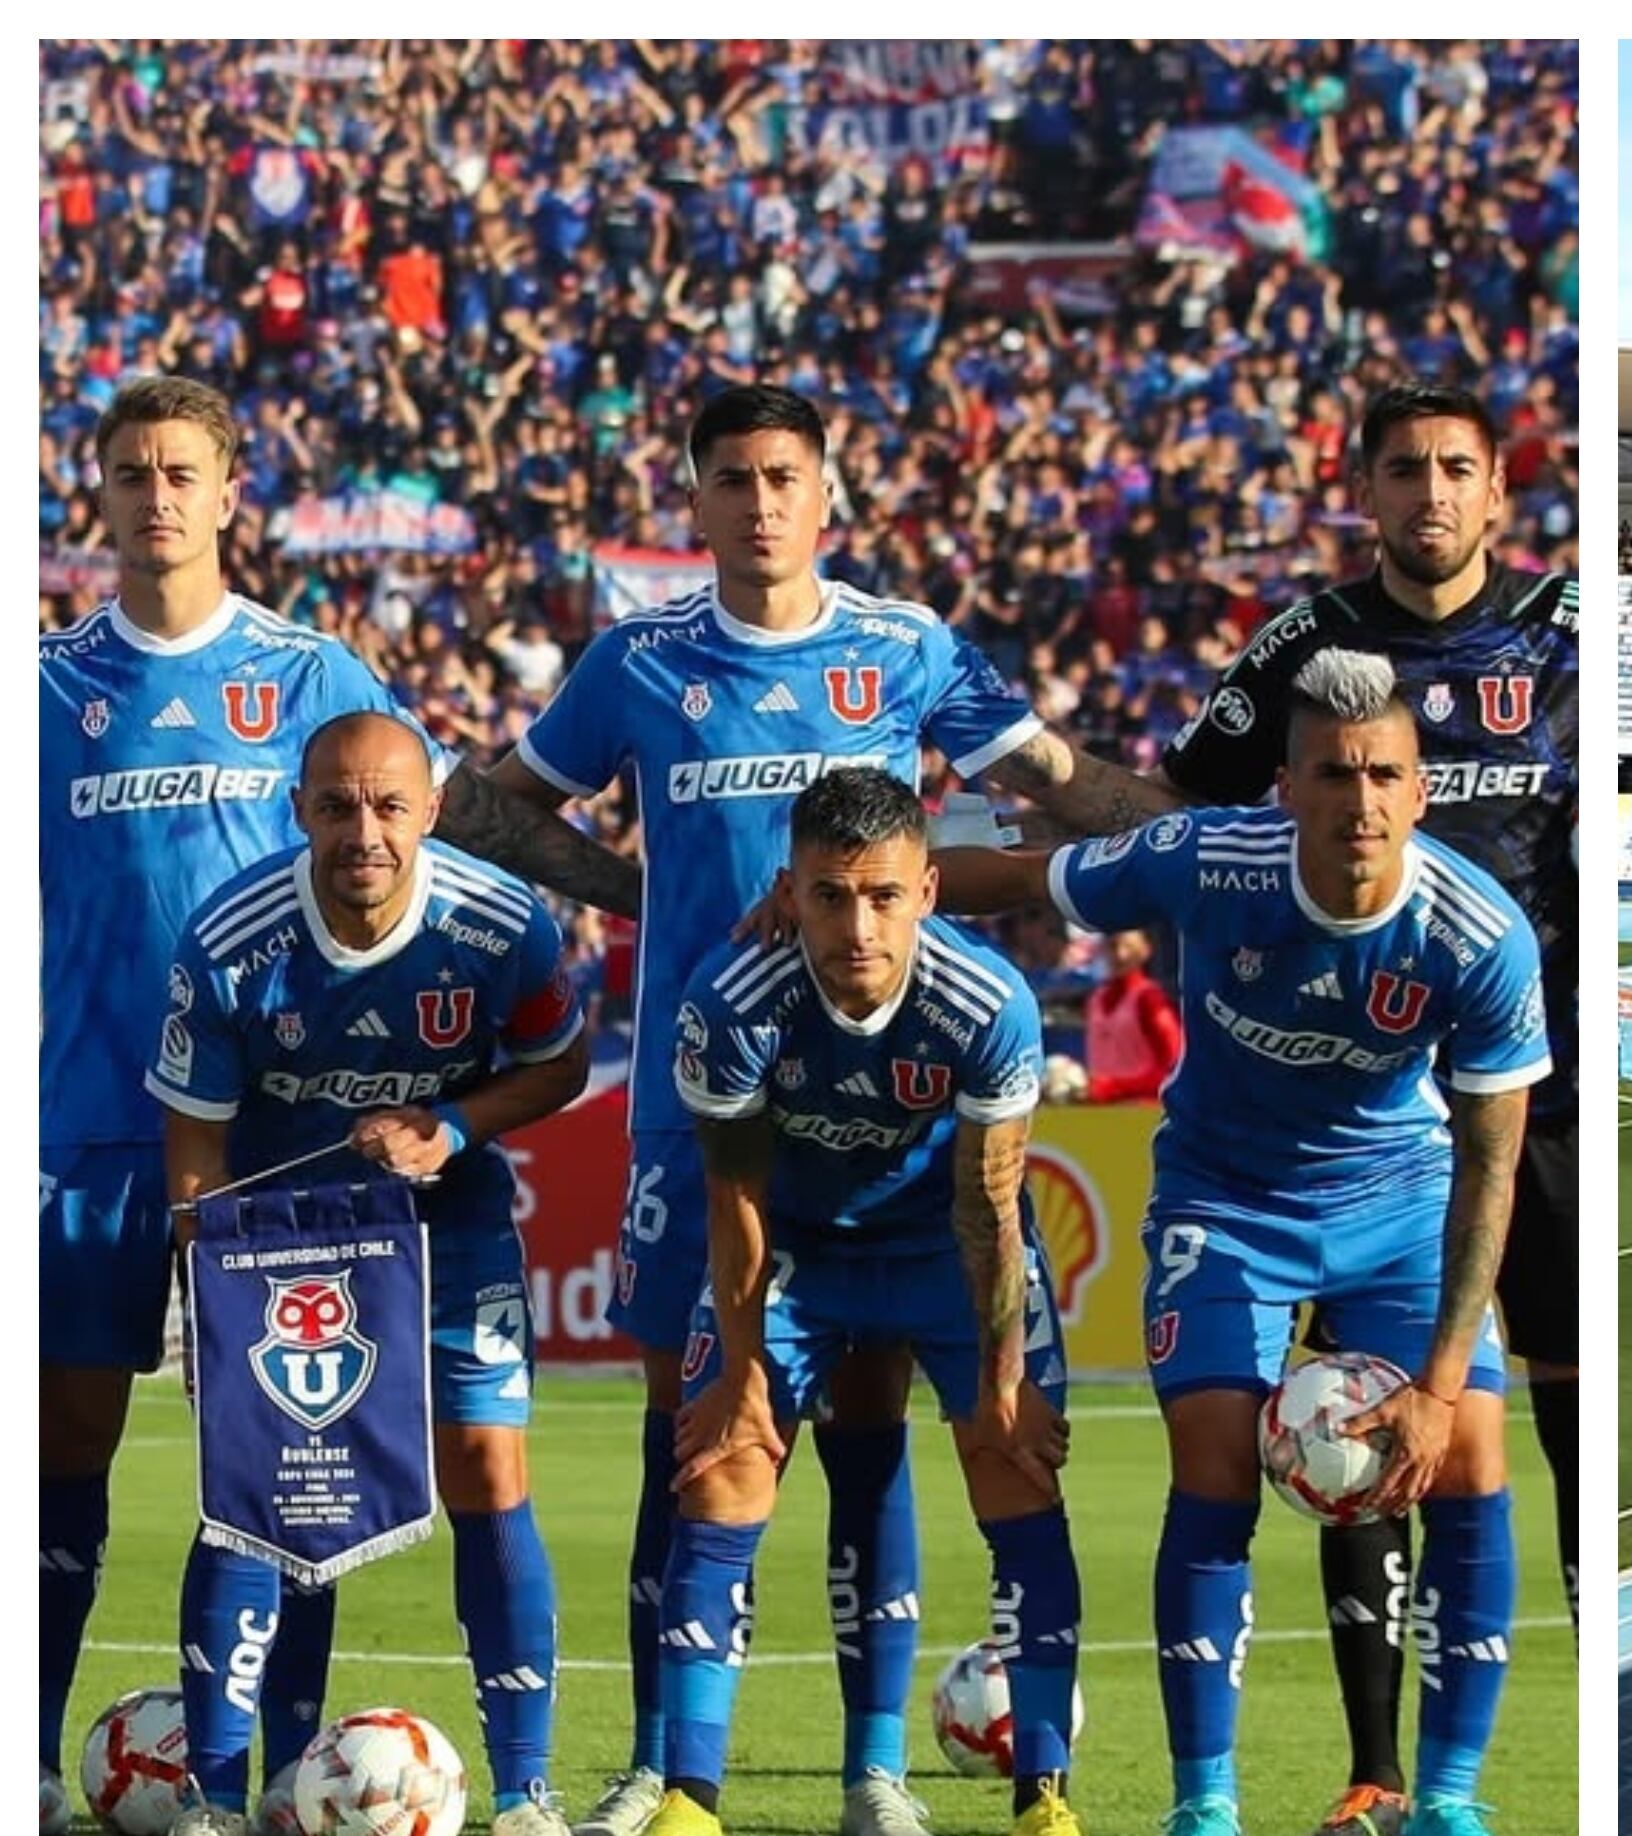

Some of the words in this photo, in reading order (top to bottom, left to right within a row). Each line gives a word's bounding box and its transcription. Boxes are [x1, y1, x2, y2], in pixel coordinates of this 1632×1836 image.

[1251, 615, 1318, 669] MACH
[222, 682, 280, 742] U
[824, 667, 882, 725] U
[1477, 676, 1534, 734] U
[1200, 869, 1280, 892] MACH
[232, 924, 299, 986] MACH
[416, 986, 475, 1049] U
[1366, 969, 1432, 1034] U
[892, 1057, 951, 1110] U
[222, 1253, 254, 1270] CLUB
[359, 1240, 395, 1257] CHILE
[1157, 1223, 1207, 1296] 9
[282, 1351, 343, 1405] U
[225, 1608, 280, 1715] AOC
